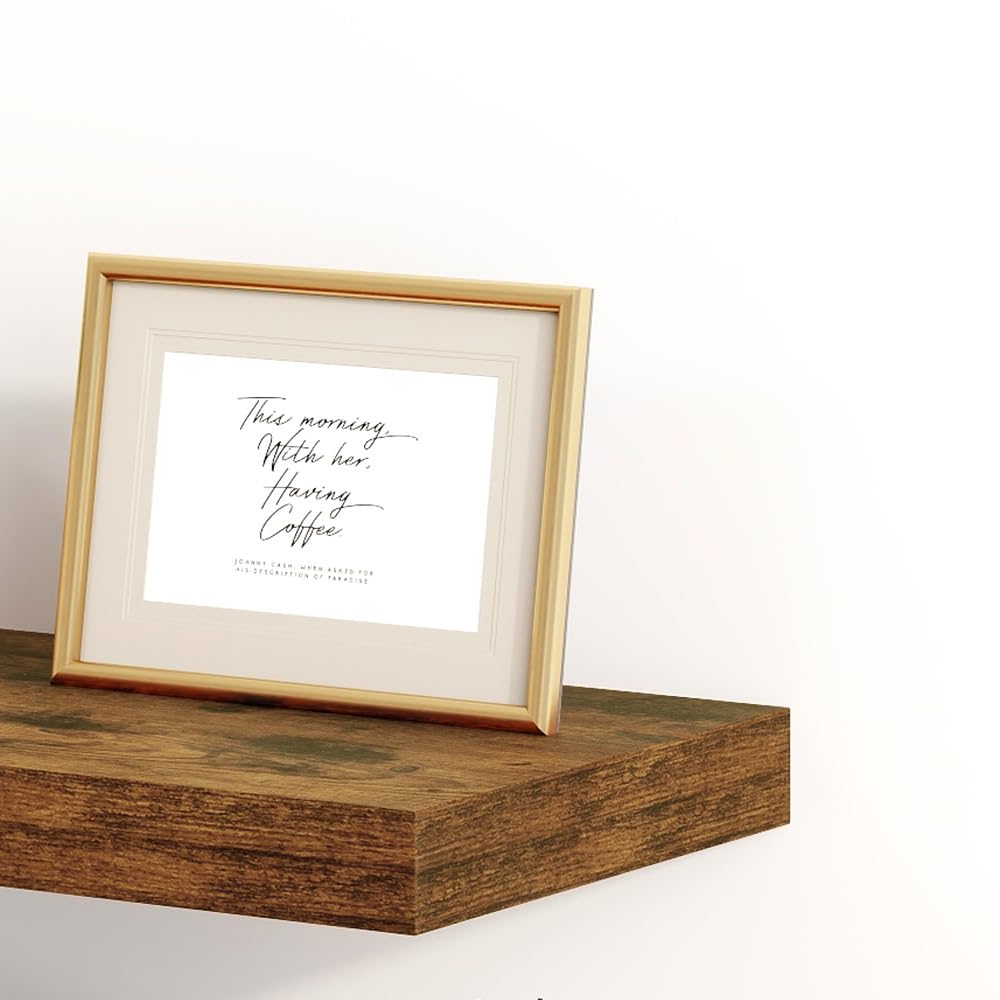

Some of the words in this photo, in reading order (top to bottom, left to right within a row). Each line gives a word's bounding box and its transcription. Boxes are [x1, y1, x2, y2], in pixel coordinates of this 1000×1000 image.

[237, 396, 292, 431] This
[300, 413, 419, 450] morning,
[257, 428, 325, 472] With
[261, 468, 385, 519] Having
[234, 558, 267, 567] JOHNNY
[300, 564, 323, 572] WHEN
[327, 567, 354, 575] ASKED
[358, 569, 374, 577] FOR
[253, 568, 309, 579] DESCRIPTION
